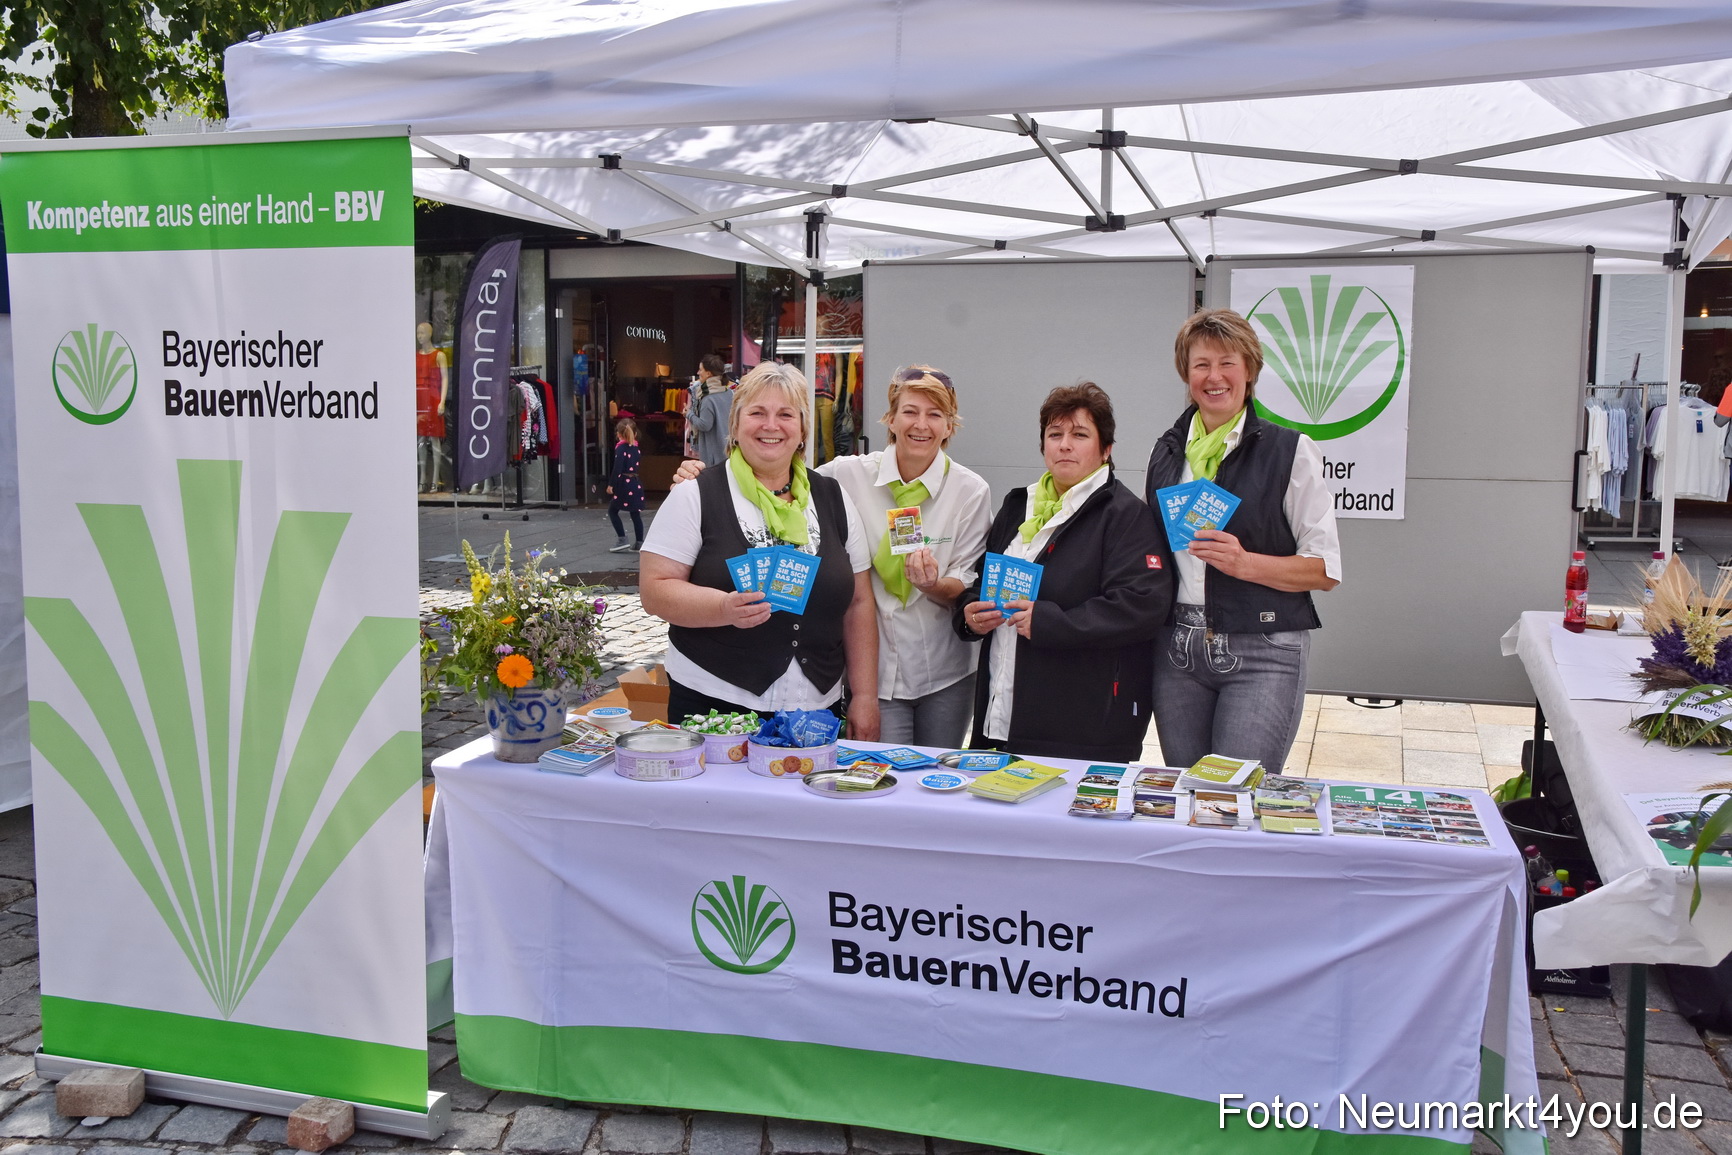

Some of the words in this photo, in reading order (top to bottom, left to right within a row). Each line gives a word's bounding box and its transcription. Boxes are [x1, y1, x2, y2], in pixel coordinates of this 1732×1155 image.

[27, 200, 150, 235] Kompetenz
[156, 205, 193, 227] aus
[199, 196, 253, 226] einer
[257, 192, 313, 224] Hand
[335, 190, 384, 223] BBV
[162, 330, 324, 377] Bayerischer
[164, 379, 379, 419] BauernVerband
[1192, 504, 1207, 516] DAS
[1196, 499, 1208, 509] SIE
[1207, 505, 1224, 518] SICH
[1200, 491, 1229, 512] SÄEN
[777, 567, 789, 575] SIE
[790, 570, 807, 580] SICH
[779, 559, 810, 574] SÄEN
[1005, 567, 1033, 583] SÄEN
[775, 573, 791, 582] DAS
[1003, 581, 1016, 590] DAS
[1004, 575, 1015, 583] SIE
[1016, 579, 1031, 589] SICH
[1354, 787, 1417, 804] 14
[828, 891, 1093, 954] Bayerischer
[831, 938, 1188, 1019] BauernVerband
